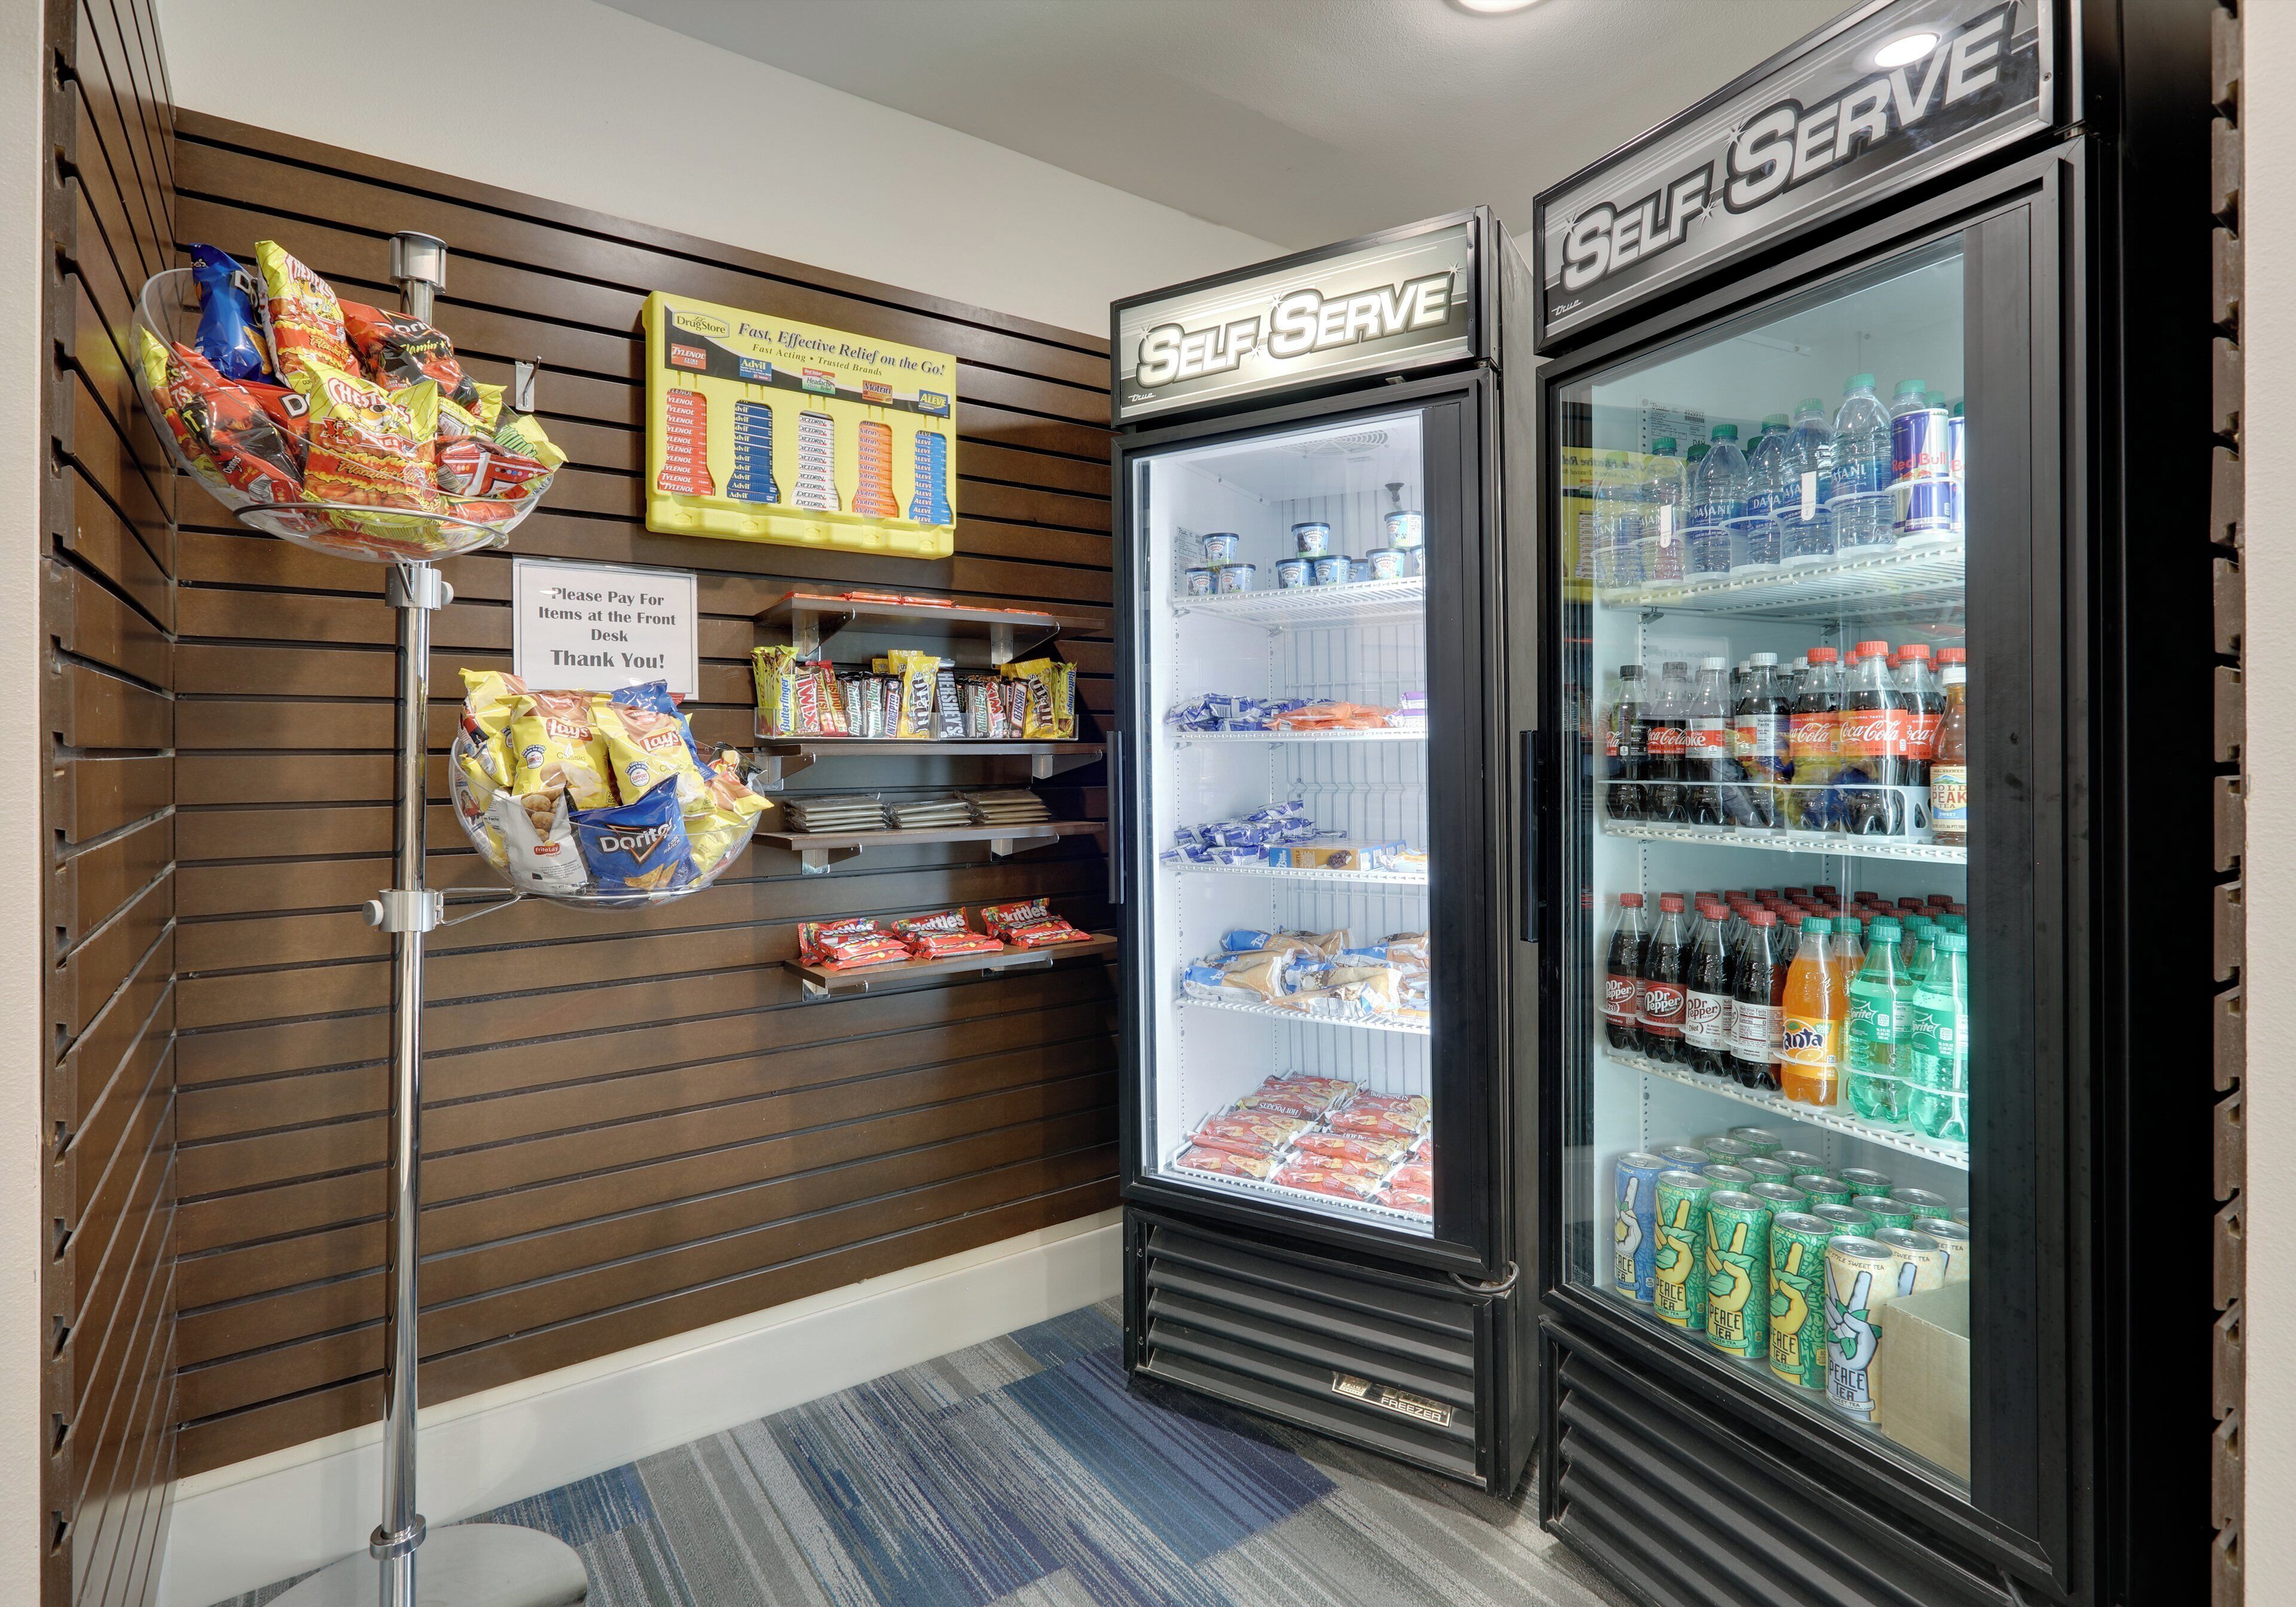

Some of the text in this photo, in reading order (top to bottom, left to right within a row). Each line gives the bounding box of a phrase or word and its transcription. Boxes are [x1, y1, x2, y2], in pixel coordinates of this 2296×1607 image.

[1561, 2, 2014, 297] SELF SERVE
[1137, 273, 1454, 387] SELF SERVE
[672, 347, 706, 360] TYLENOL
[738, 322, 946, 375] Fast, Effective Relief on the Go!
[741, 359, 766, 370] Advil
[752, 344, 883, 376] Fast Acting Trusted Brands
[807, 377, 832, 387] Headache
[863, 382, 891, 395] Motrin
[920, 393, 947, 407] ALEVE
[222, 455, 243, 475] Doritos
[1892, 454, 1916, 472] Red
[1919, 451, 1946, 466] Bull
[662, 473, 691, 483] TYLENOL
[796, 481, 825, 490] EXCEDRIN
[664, 482, 694, 493] TYLENOL
[796, 491, 826, 499] EXCEDRIN
[796, 499, 825, 508] EXCEDRIN
[855, 498, 877, 506] Motrin
[1754, 496, 1782, 509] DASA
[1694, 505, 1730, 518] DASANI
[551, 587, 664, 606] Please Pay For
[539, 606, 676, 625] Items at the Front
[591, 629, 628, 642] Desk
[550, 649, 664, 669] Thank You!
[796, 673, 818, 728] TWIX
[1067, 671, 1075, 714] Butterfinger
[780, 678, 791, 731] Butterfinger
[938, 673, 965, 737] HERSHEY'S
[987, 682, 1006, 728] TWIX
[1013, 689, 1025, 721] RUSHED
[886, 694, 899, 735] INTERCEPTED
[1840, 720, 1901, 743] Coca-Cola
[1932, 792, 1967, 803] PEAK
[908, 914, 966, 931] Skittles
[1606, 981, 1631, 1000] Pepper
[1611, 980, 1622, 989] Dr
[1645, 991, 1681, 1015] Pepper
[1655, 990, 1671, 1001] Dr
[1694, 998, 1708, 1009] Dr
[1687, 1000, 1717, 1020] Pepper
[1784, 1028, 1823, 1050] anta
[1259, 1102, 1299, 1116] HOT POCKETS
[1712, 1207, 1727, 1215] GREEN
[1833, 1254, 1846, 1263] STYLE
[1848, 1258, 1870, 1269] SWEET
[1656, 1276, 1683, 1301] PEACE
[1660, 1295, 1675, 1310] TEA
[1709, 1304, 1741, 1330] PEACE
[1715, 1324, 1732, 1340] TEA
[1773, 1347, 1787, 1364] TEA
[1830, 1359, 1864, 1391] PEACE
[1832, 1395, 1847, 1404] SWEET
[1836, 1382, 1854, 1401] TEA
[1381, 1397, 1441, 1422] FREEZER
